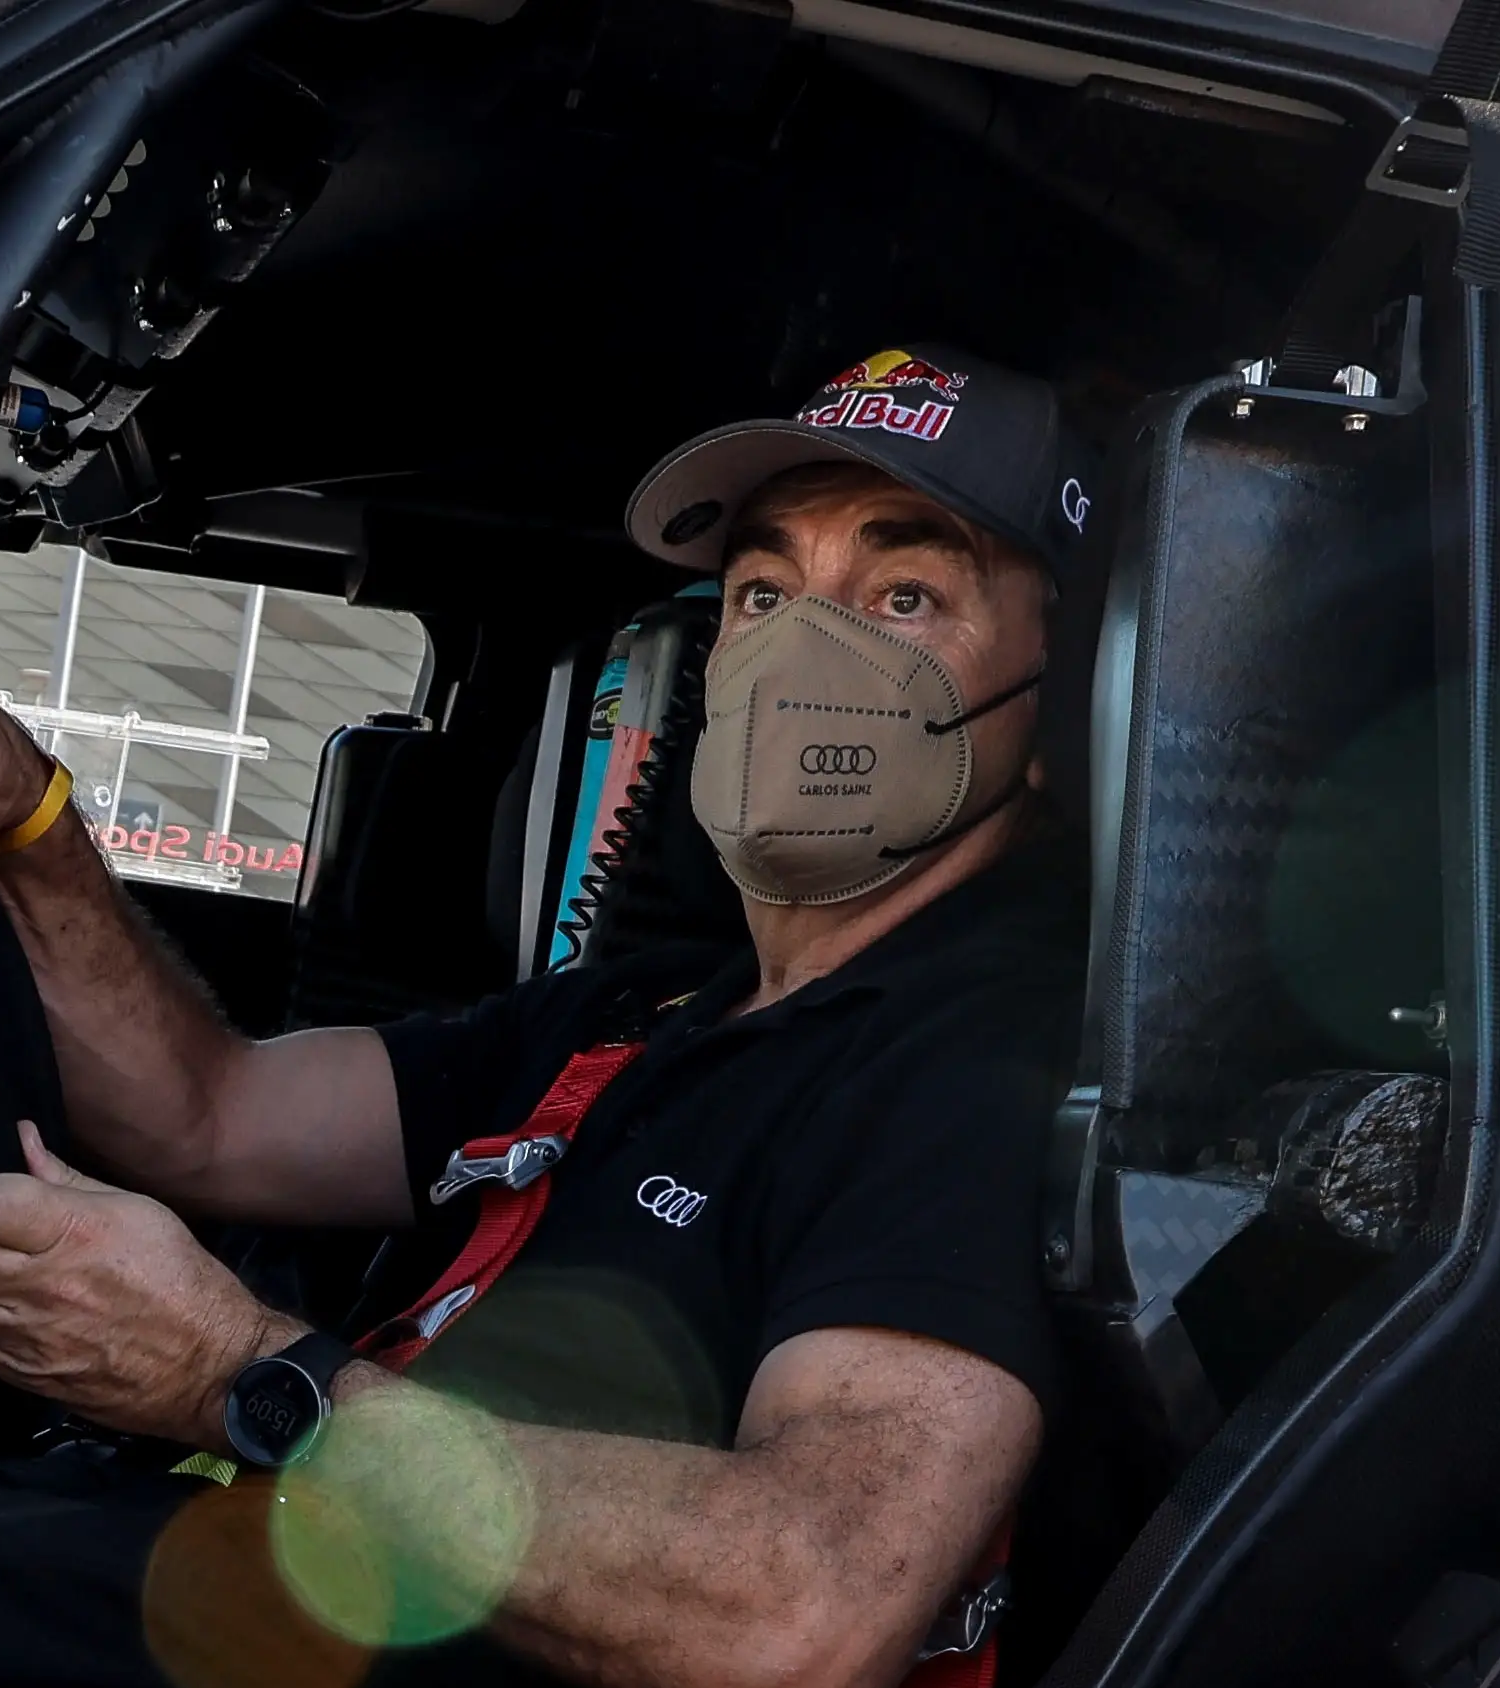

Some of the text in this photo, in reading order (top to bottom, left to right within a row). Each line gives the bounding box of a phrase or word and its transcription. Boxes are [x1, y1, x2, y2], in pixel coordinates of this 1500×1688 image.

[846, 393, 955, 441] Bull
[799, 784, 872, 796] CARLOS SAINZ
[246, 1393, 297, 1437] 15:09
